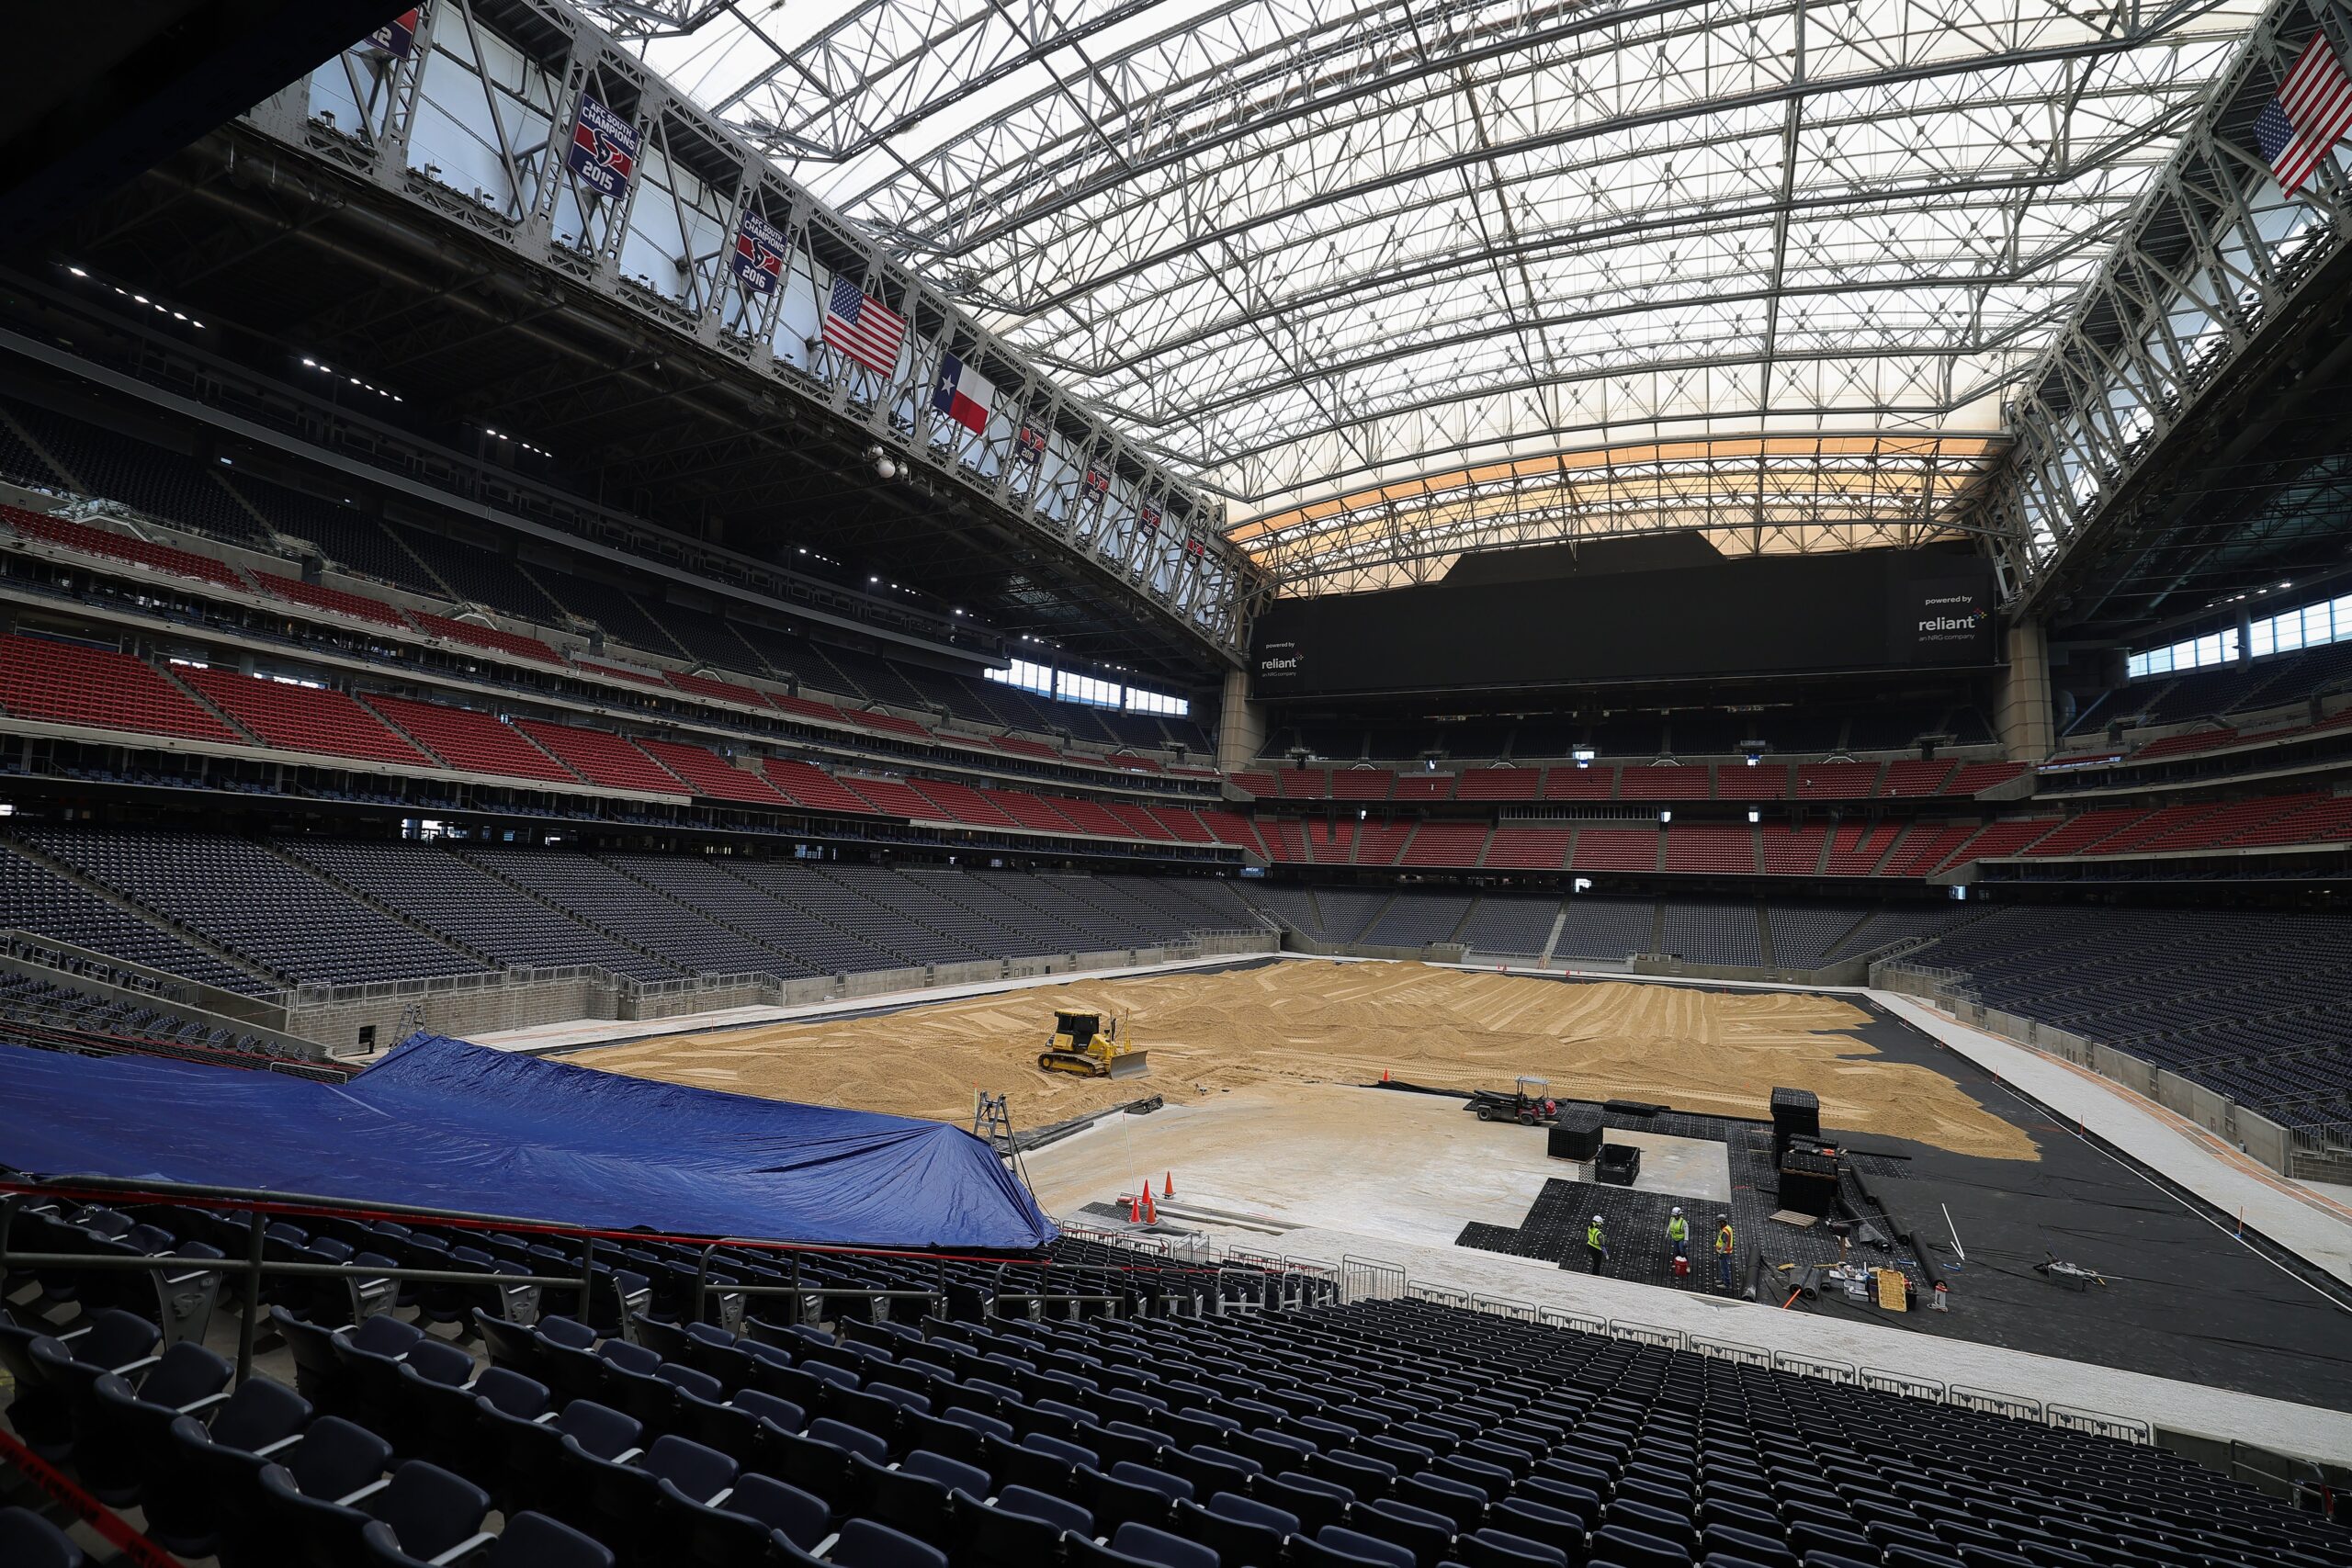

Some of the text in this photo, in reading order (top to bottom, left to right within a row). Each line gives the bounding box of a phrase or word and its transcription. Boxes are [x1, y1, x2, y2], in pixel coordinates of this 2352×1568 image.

[591, 103, 632, 137] AFC SOUTH
[582, 107, 636, 151] CHAMPIONS
[582, 160, 614, 191] 2015
[744, 220, 785, 253] CHAMPIONS
[751, 217, 783, 242] AFC SOUTH
[742, 265, 766, 288] 2016
[1025, 416, 1046, 435] CHAMPIONS
[1035, 418, 1046, 429] SOUTH
[1021, 447, 1035, 461] 2018
[1091, 461, 1110, 477] CHAMPIONS
[1925, 595, 1973, 605] powered by
[1918, 615, 1975, 631] reliant
[1265, 641, 1288, 649] powered
[1261, 657, 1297, 670] reliant
